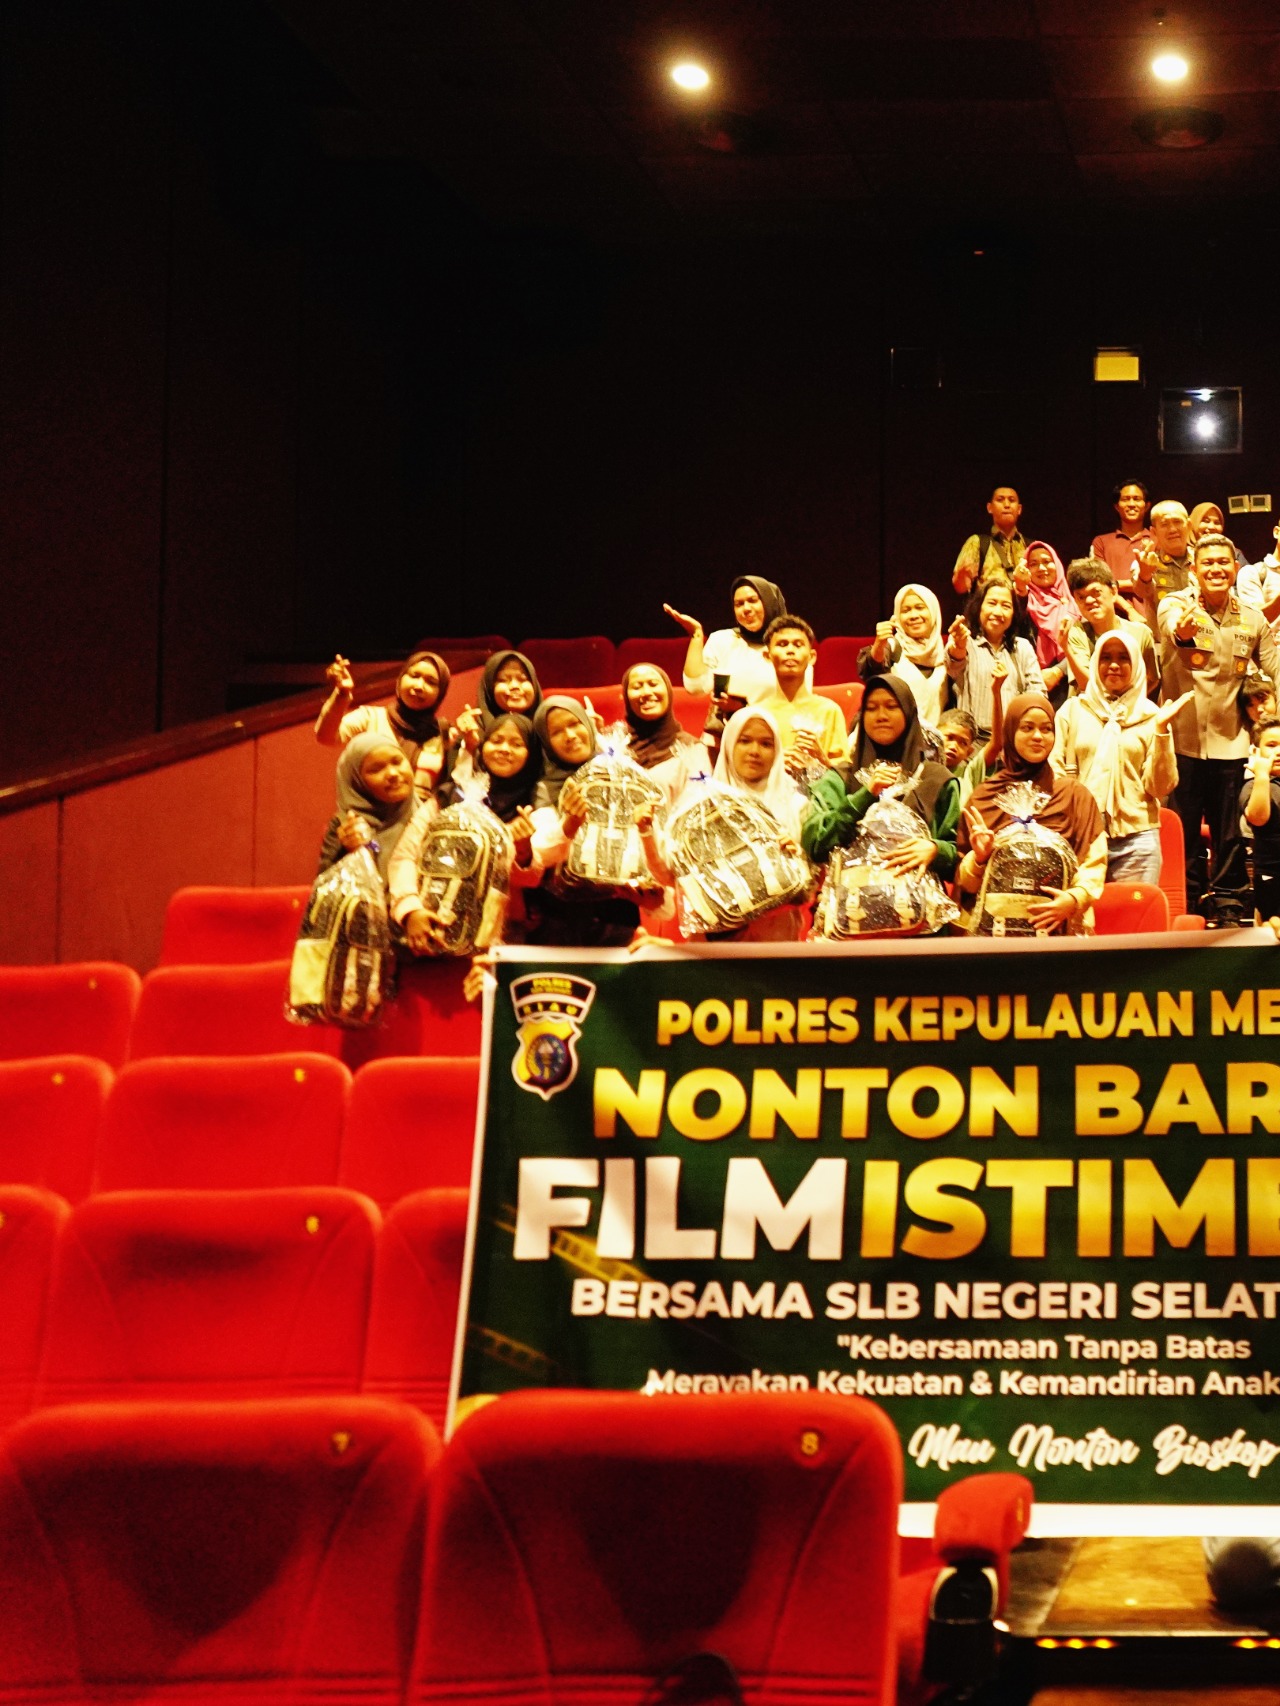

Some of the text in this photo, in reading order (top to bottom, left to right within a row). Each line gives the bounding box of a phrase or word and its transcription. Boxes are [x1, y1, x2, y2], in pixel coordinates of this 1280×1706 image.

[657, 998, 859, 1045] POLRES
[874, 990, 1194, 1041] KEPULAUAN
[594, 1065, 1040, 1140] NONTON
[513, 1157, 847, 1261] FILM
[571, 1279, 813, 1320] BERSAMA
[825, 1282, 919, 1320] SLB
[934, 1281, 1117, 1320] NEGERI
[837, 1334, 1251, 1364] "Kebersamaan Tanpa Batas
[817, 1369, 963, 1396] Kekuatan
[970, 1371, 992, 1396] &
[1001, 1369, 1194, 1396] Kemandirian
[908, 1424, 996, 1471] Mau
[1009, 1424, 1139, 1471] Nonton
